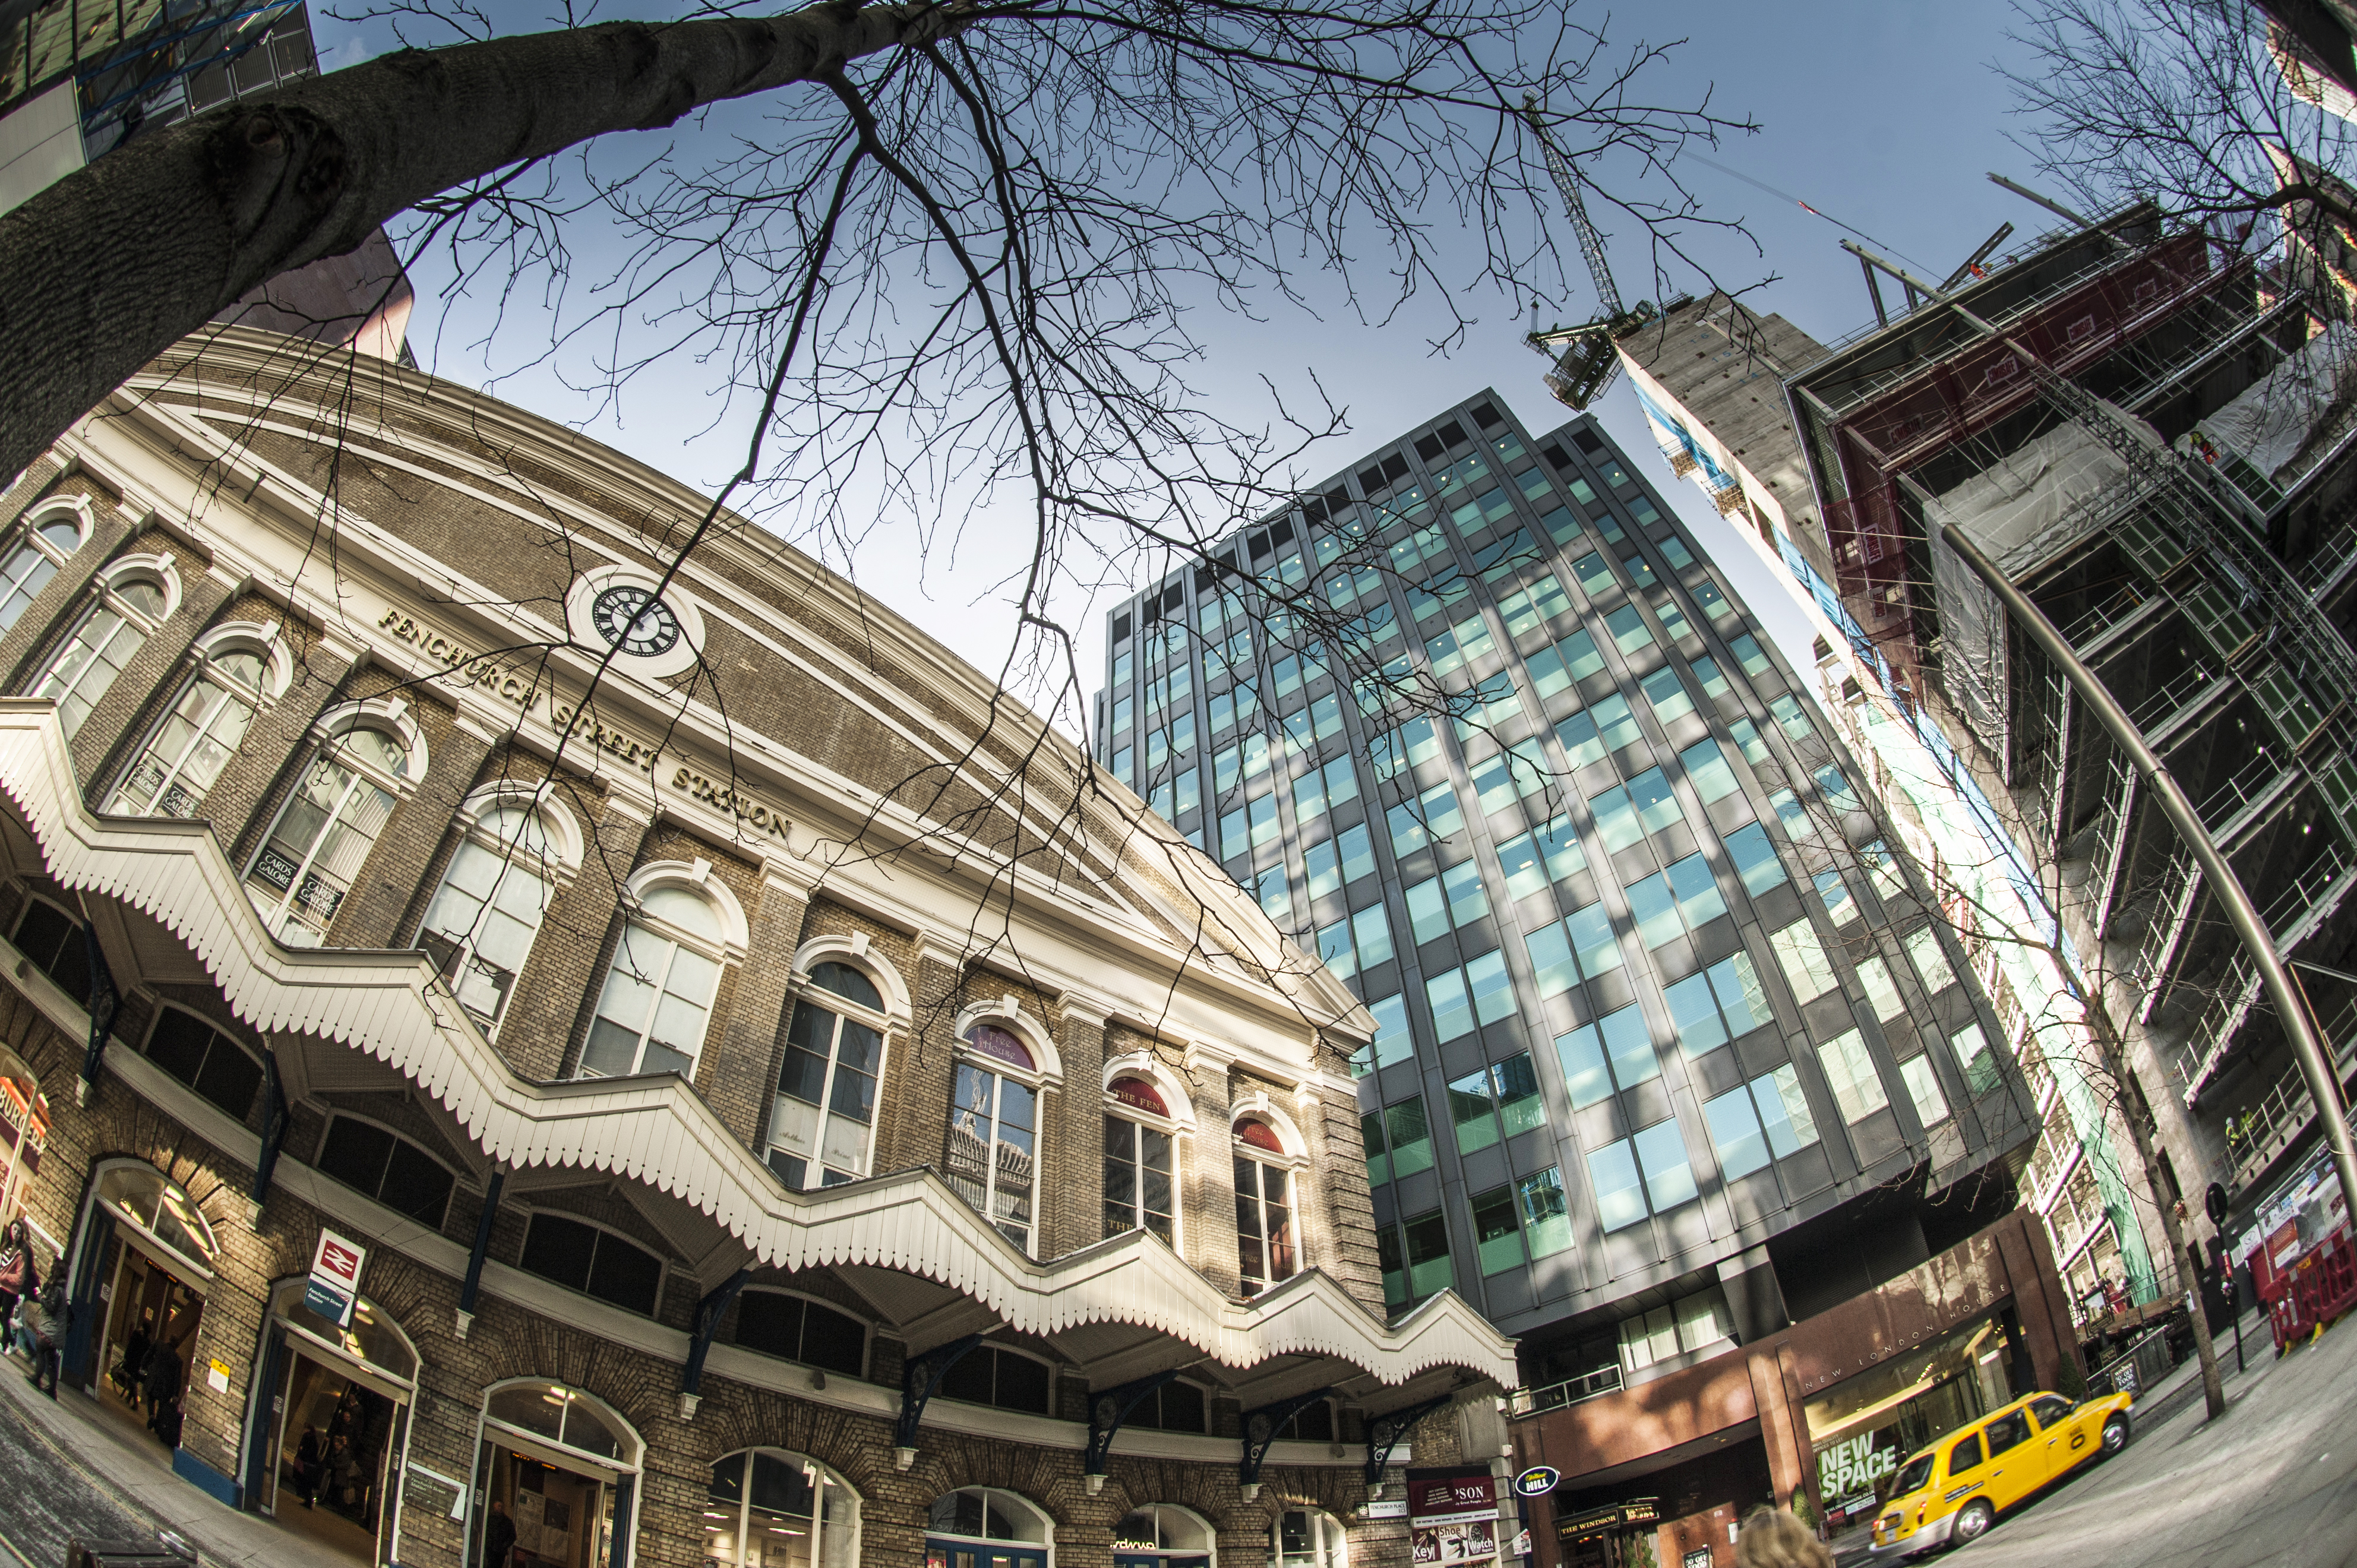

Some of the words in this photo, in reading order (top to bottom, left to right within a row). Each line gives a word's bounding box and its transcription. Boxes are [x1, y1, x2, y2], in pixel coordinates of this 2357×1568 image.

[377, 607, 542, 712] FENCHURCH
[551, 704, 661, 773] STREET
[672, 767, 794, 839] STATION
[137, 764, 160, 785] CARDS
[165, 796, 194, 818] GALORE
[171, 791, 196, 811] CARDS
[258, 861, 291, 886] GALORE
[265, 855, 293, 876] CARDS
[301, 888, 335, 913] GALORE
[307, 881, 337, 903] CARDS
[989, 1031, 1012, 1048] Free
[982, 1040, 1016, 1060] House
[1113, 1088, 1136, 1103] THE
[1140, 1098, 1161, 1111] FEN
[1242, 1131, 1269, 1147] House
[1246, 1123, 1265, 1137] Free
[1107, 1219, 1133, 1232] THE
[308, 1287, 330, 1301] Fenchurch
[330, 1298, 343, 1308] Street
[308, 1293, 323, 1304] Station
[1805, 1368, 1841, 1390] NEW
[1859, 1324, 1934, 1365] LONDON
[1950, 1284, 2005, 1320] HOUSE
[1821, 1429, 1874, 1475] NEW
[1821, 1444, 1897, 1499] SPACE
[432, 1486, 446, 1494] Street
[1525, 1477, 1549, 1492] HILL
[1439, 1526, 1461, 1537] Shoe
[1560, 1525, 1578, 1535] THE
[1578, 1515, 1617, 1530] WINDSOR
[1413, 1545, 1433, 1561] Key
[1469, 1537, 1493, 1550] Watch
